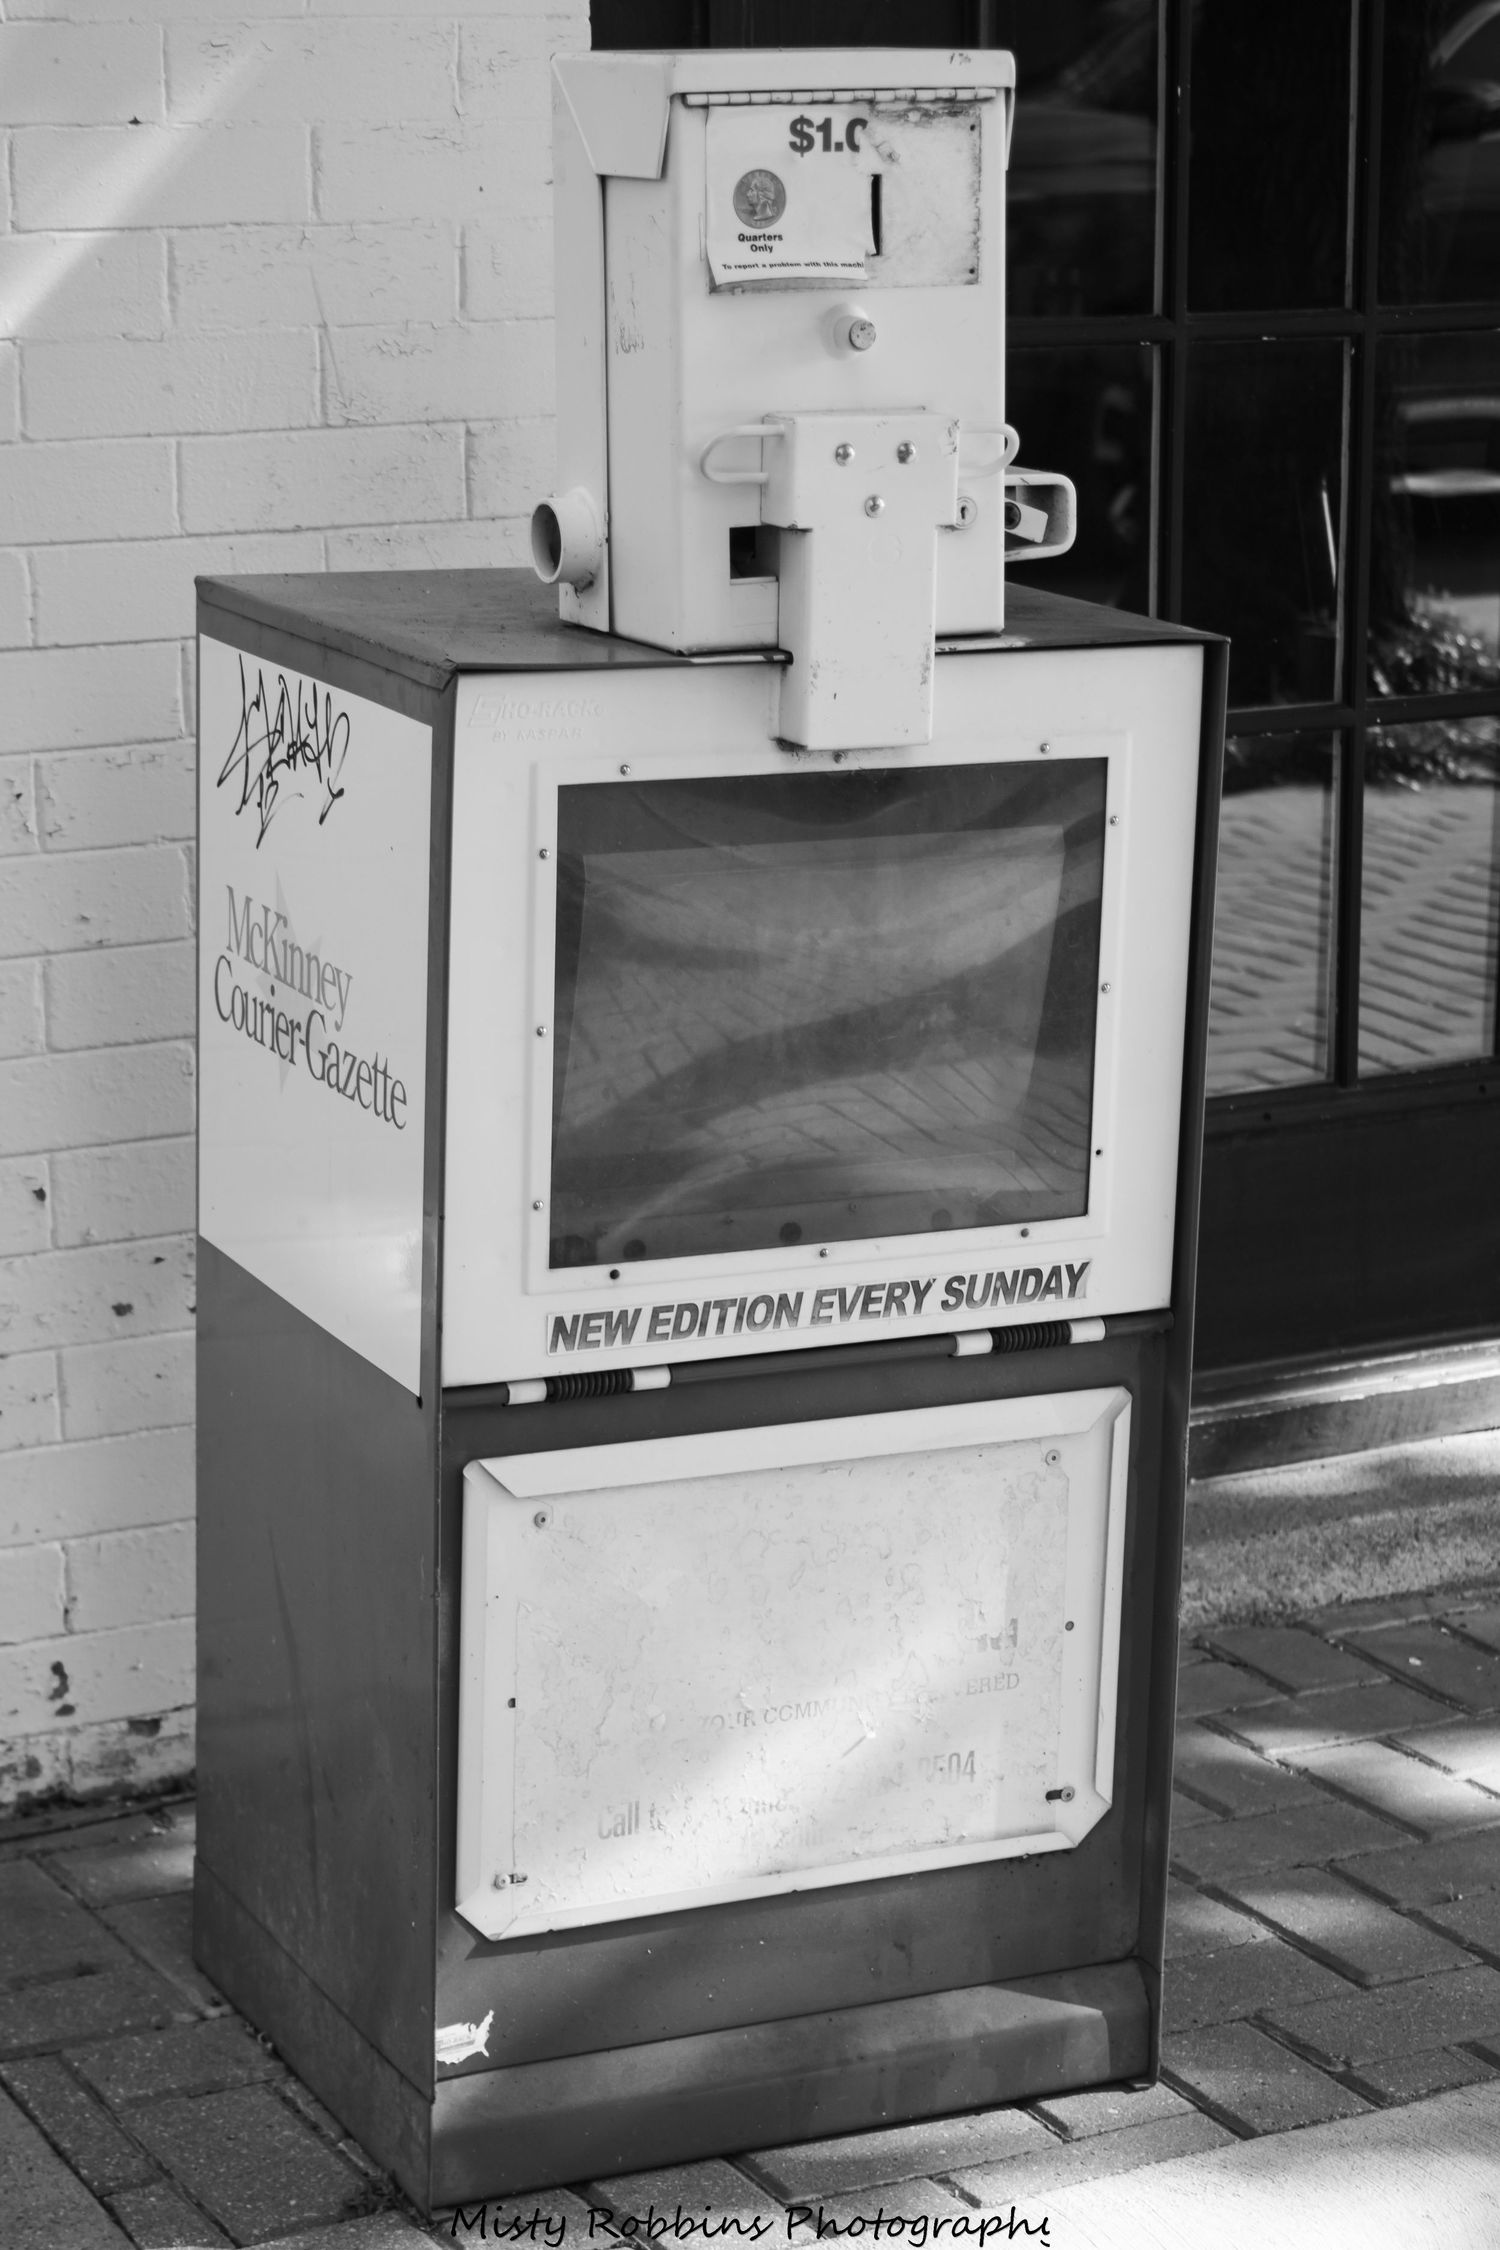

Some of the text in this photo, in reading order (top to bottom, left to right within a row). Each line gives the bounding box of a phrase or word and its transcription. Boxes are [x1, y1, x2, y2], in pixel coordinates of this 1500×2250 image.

[737, 232, 784, 243] Quarters
[749, 243, 774, 254] Only
[721, 263, 733, 271] To
[734, 262, 760, 270] report
[769, 261, 802, 270] problem
[803, 261, 822, 269] with
[822, 261, 839, 269] this
[225, 884, 353, 1032] McKinney
[214, 954, 407, 1131] Courier-Gazette
[549, 1260, 1091, 1354] NEW EDITION EVERY SUNDAY
